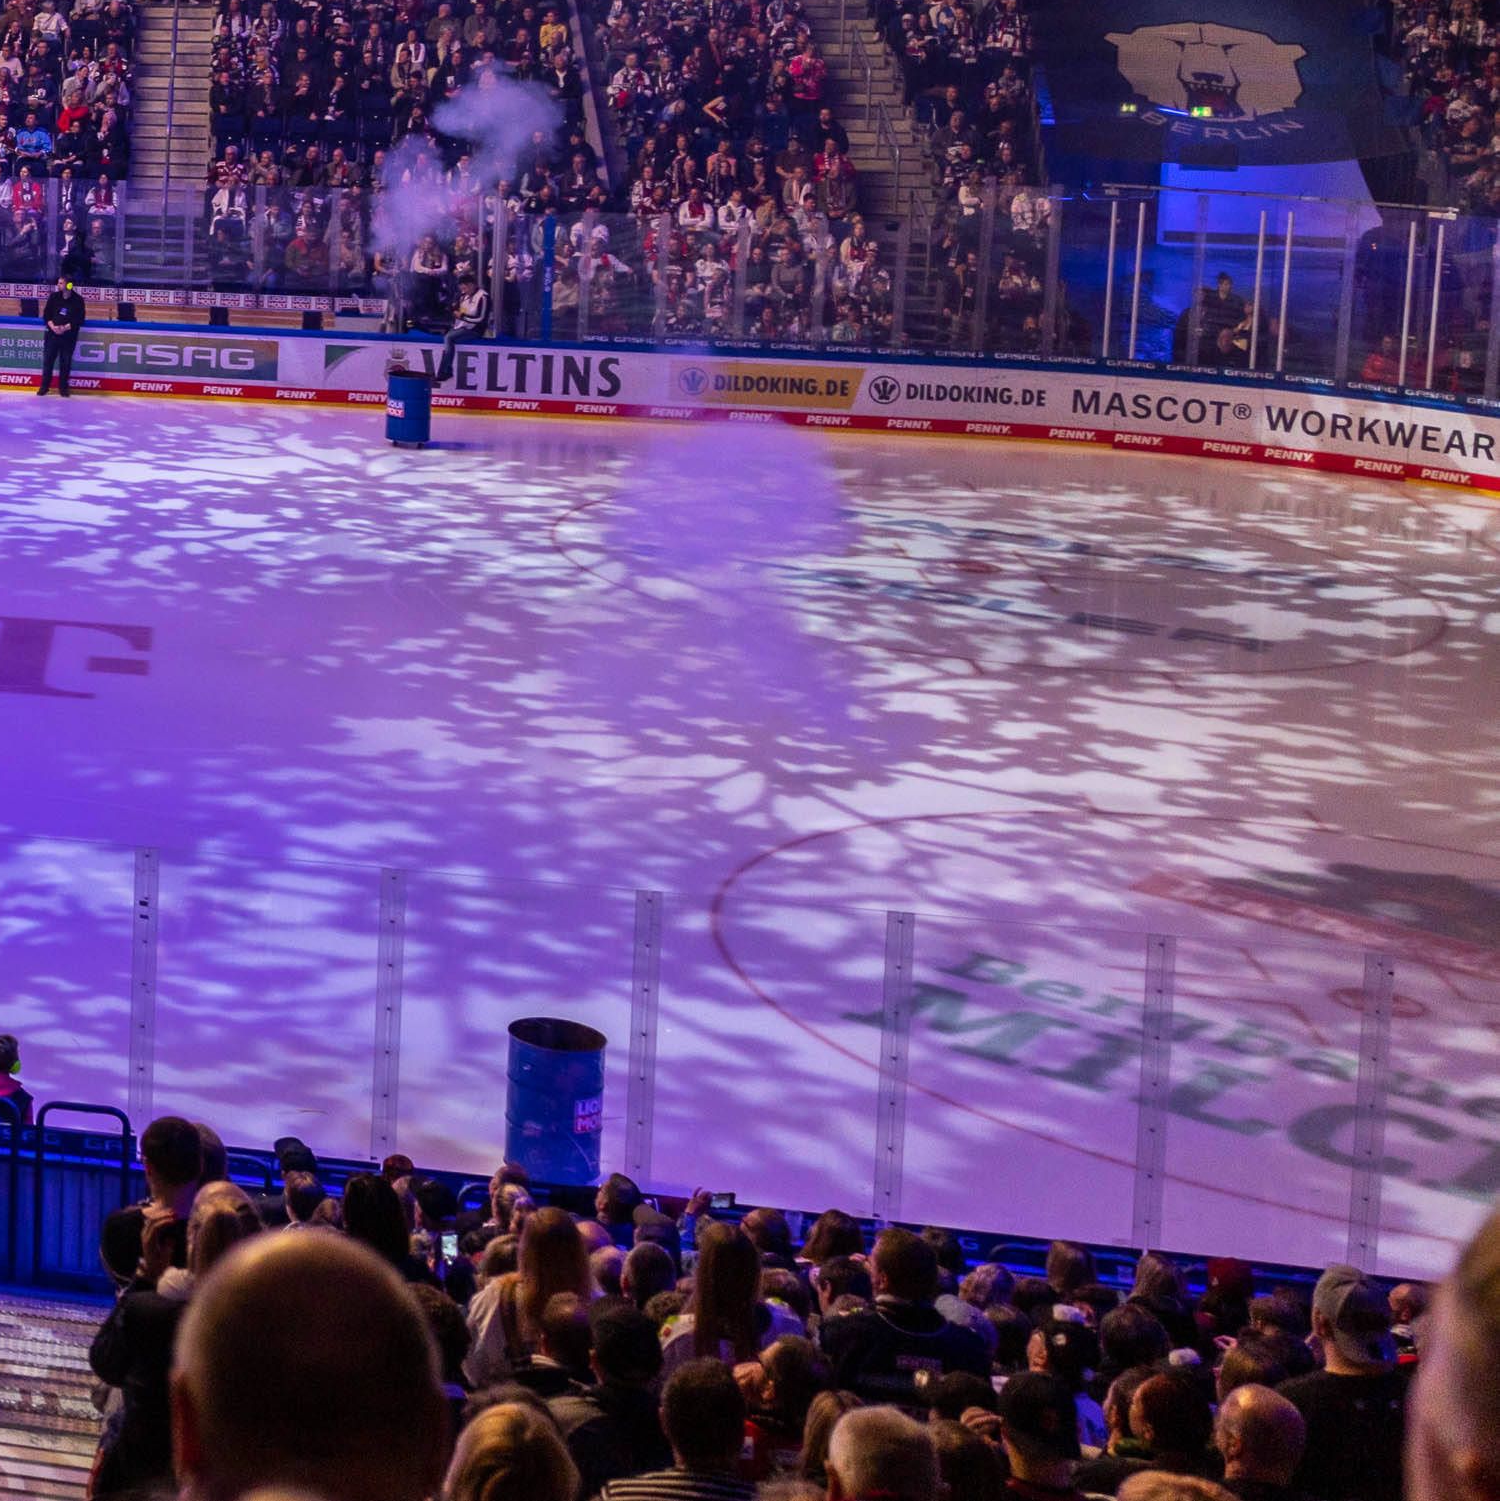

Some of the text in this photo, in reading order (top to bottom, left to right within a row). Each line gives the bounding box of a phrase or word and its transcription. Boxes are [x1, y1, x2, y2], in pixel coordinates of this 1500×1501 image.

[1139, 110, 1305, 142] BERLIN
[72, 341, 255, 371] GASAG
[994, 351, 1041, 361] GASAG
[714, 374, 850, 397] DILDOKING.DE
[1224, 369, 1275, 380] GASAG
[905, 383, 1047, 407] DILDOKING.DE
[1405, 388, 1456, 401] GASAG
[1071, 388, 1496, 461] MASCOT® WORKWEAR
